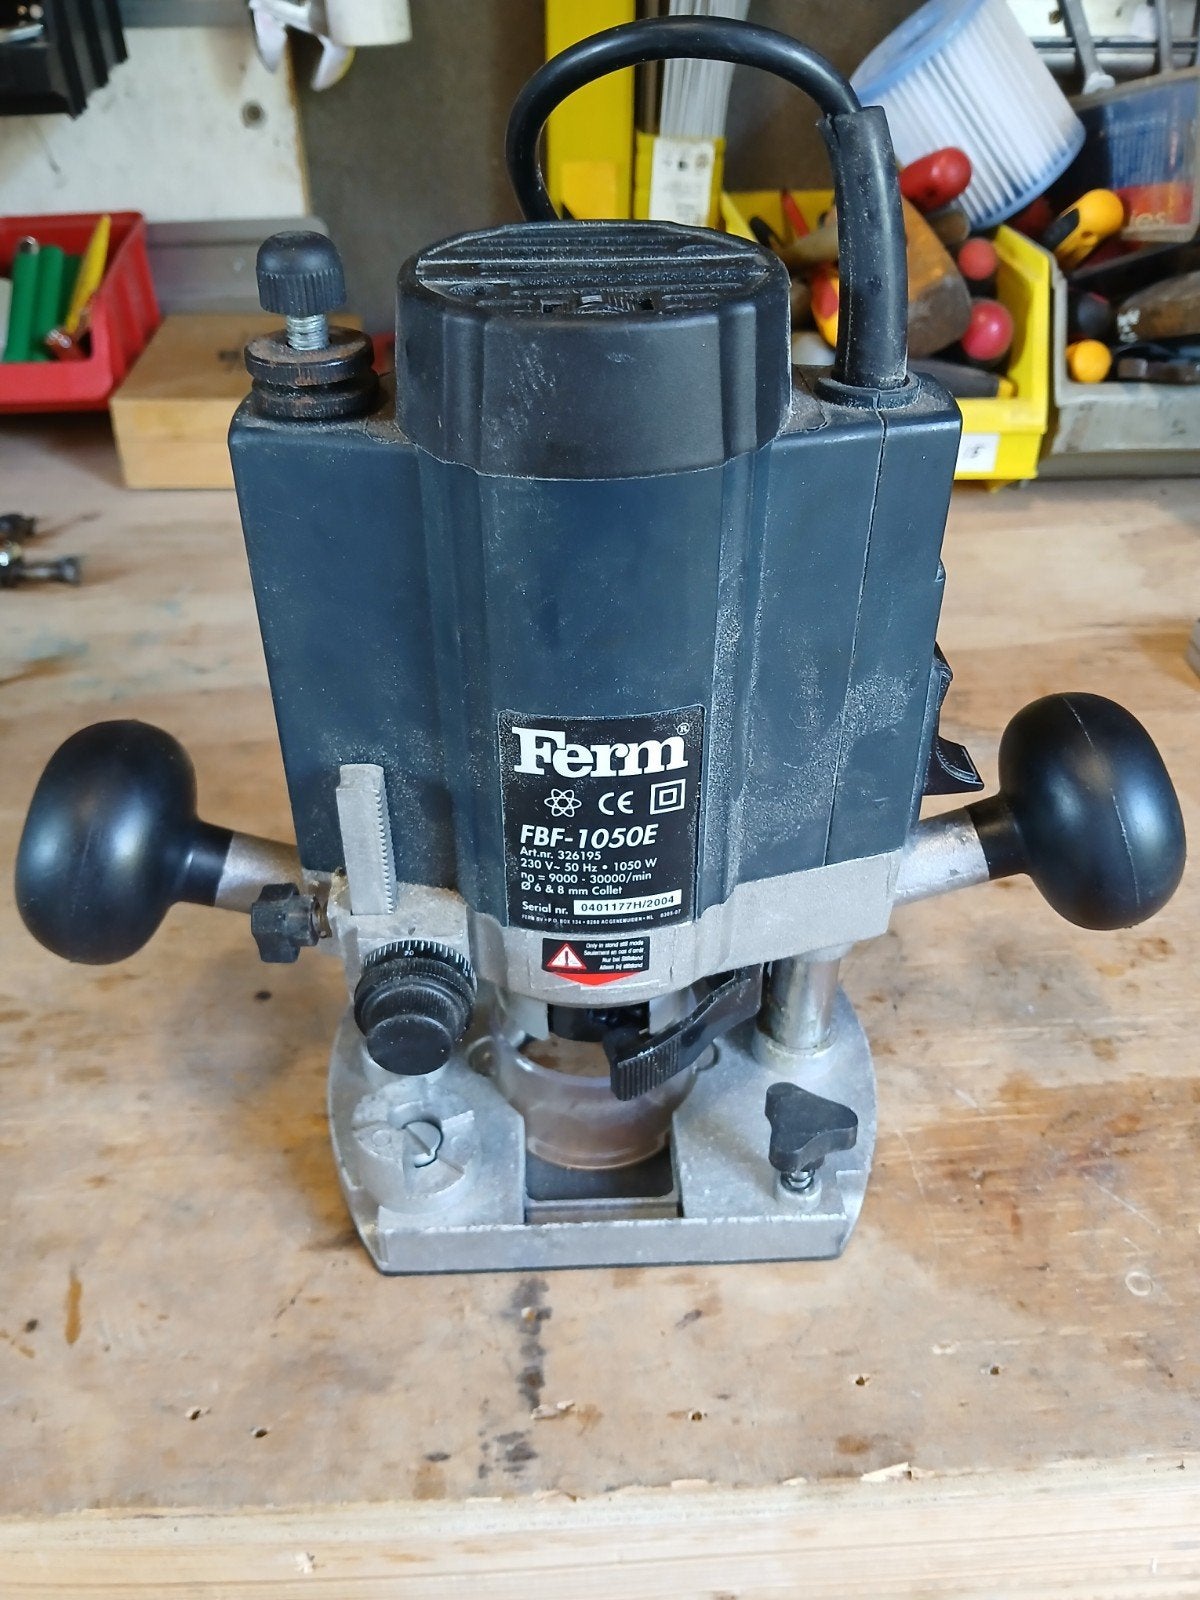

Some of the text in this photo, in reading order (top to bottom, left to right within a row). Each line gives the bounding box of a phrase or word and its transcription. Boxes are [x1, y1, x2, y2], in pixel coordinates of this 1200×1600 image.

[511, 726, 689, 778] Ferm
[598, 790, 634, 816] CE
[520, 823, 659, 849] FBF-1050E
[557, 850, 602, 861] 326195
[520, 858, 542, 869] 230
[564, 862, 580, 872] 50
[582, 862, 598, 873] Hz
[614, 860, 642, 872] 1050
[645, 857, 658, 868] W
[548, 873, 578, 884] 9000
[589, 870, 652, 884] 30000/min
[534, 883, 542, 892] 6
[545, 884, 554, 894] &
[557, 885, 565, 895] 8
[568, 887, 589, 896] mm
[591, 884, 623, 896] Collet
[521, 895, 675, 916] Serial nr. 0401177H/2004
